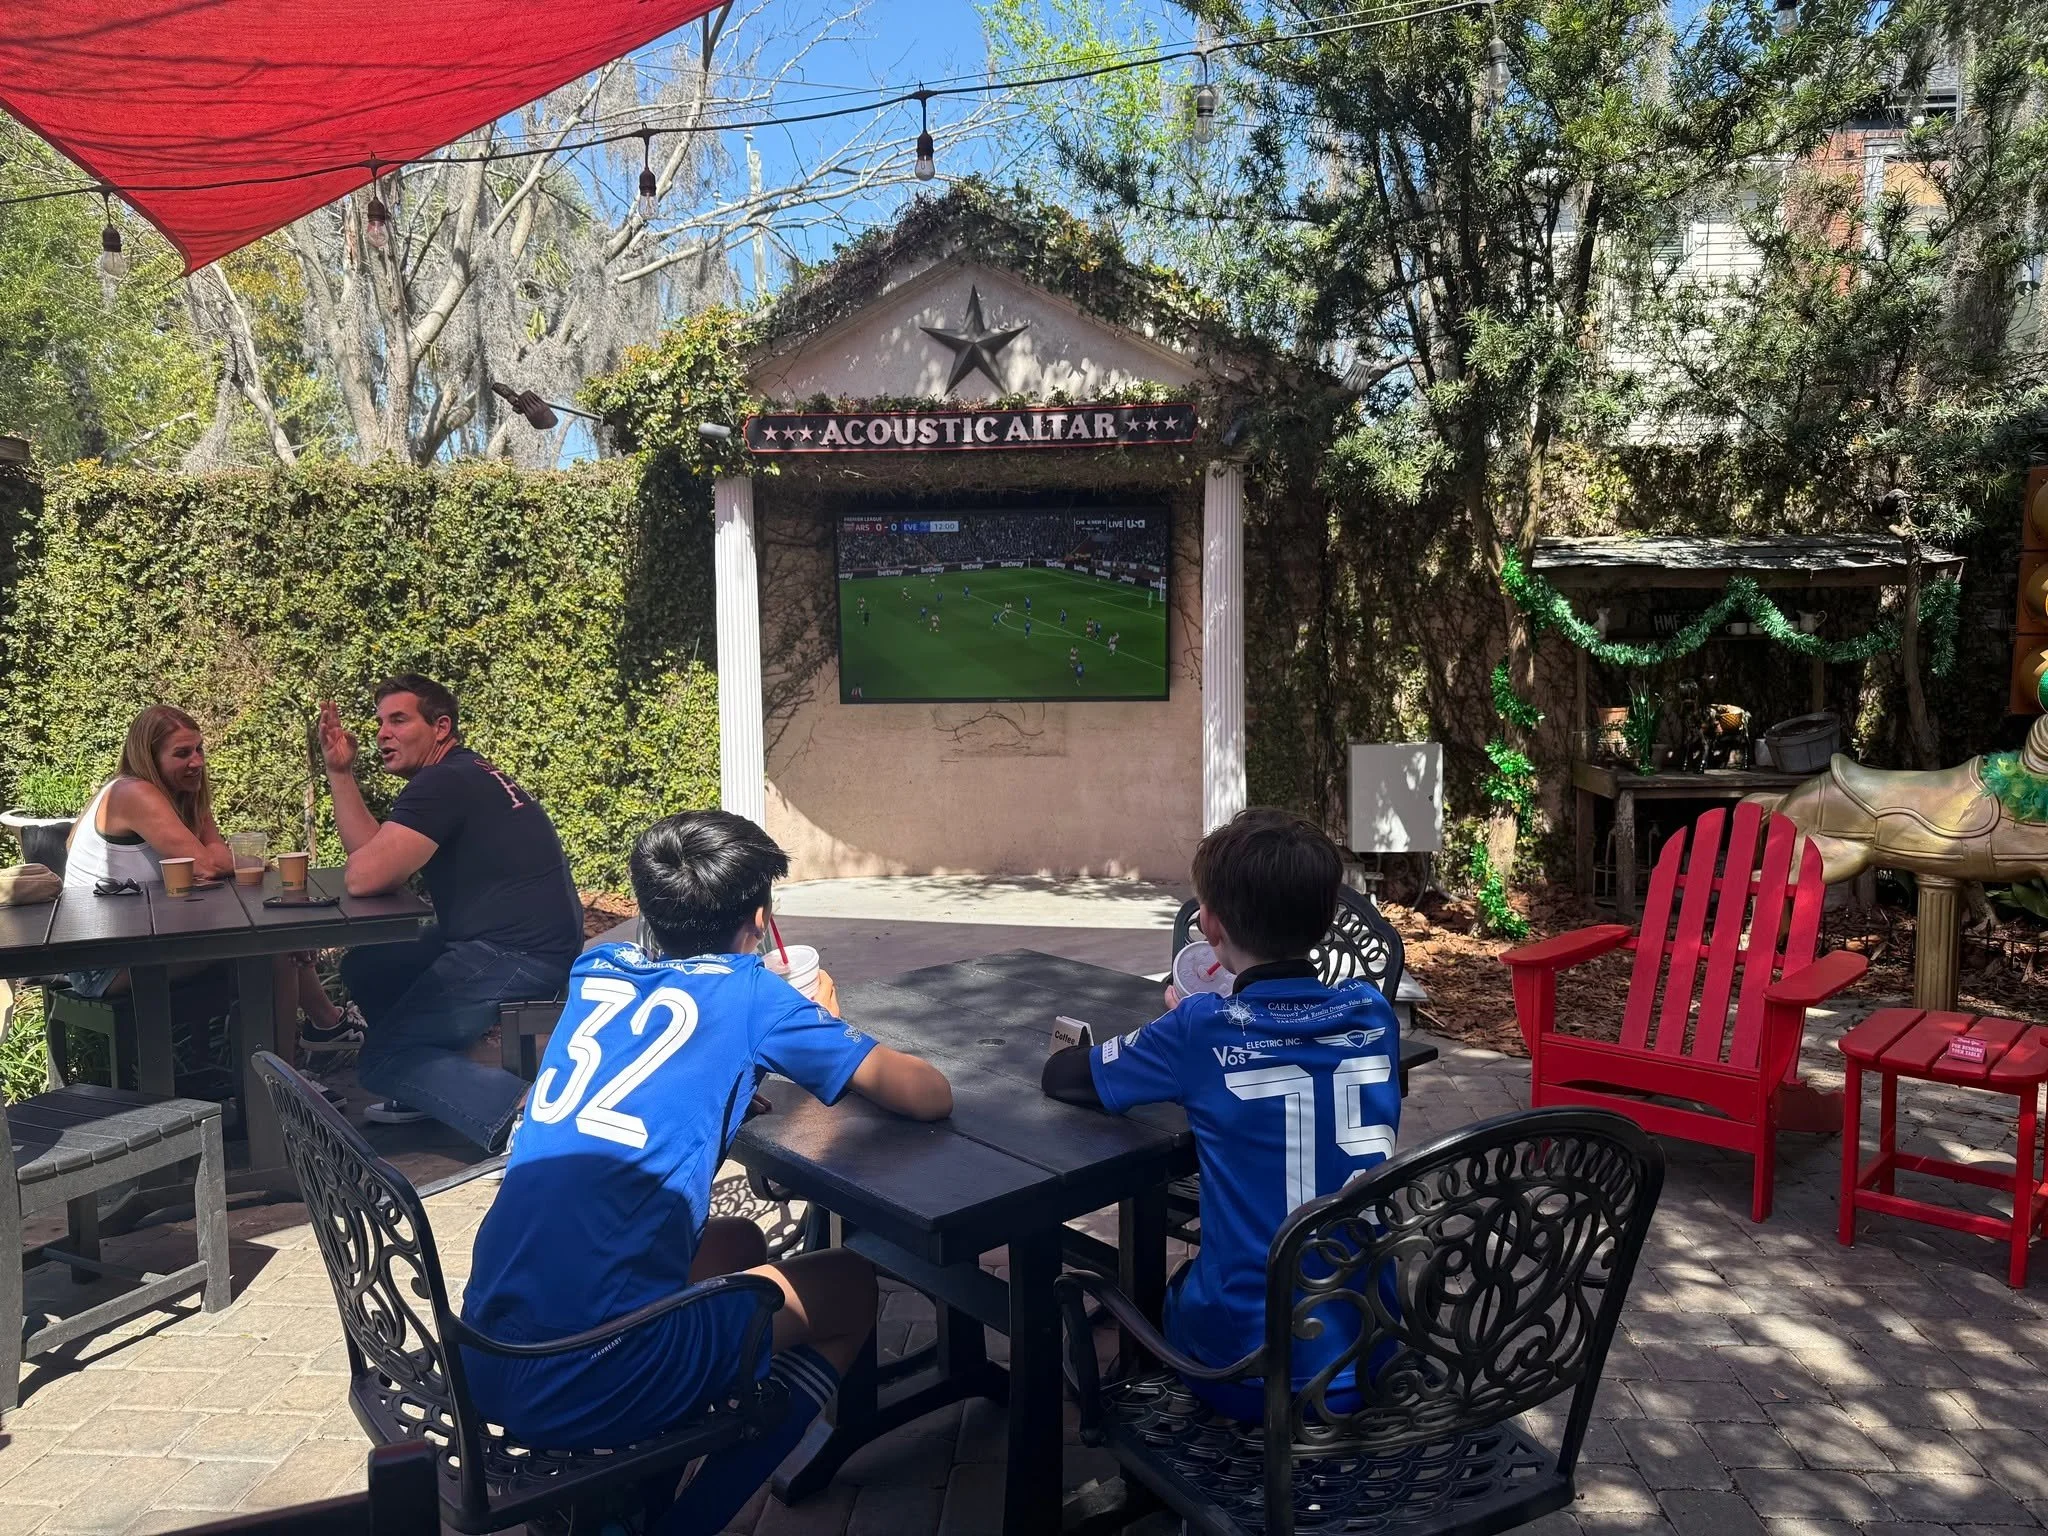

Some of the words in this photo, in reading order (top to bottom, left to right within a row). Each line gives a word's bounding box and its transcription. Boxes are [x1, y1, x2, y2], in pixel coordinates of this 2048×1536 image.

[819, 417, 998, 446] ACOUSTIC
[1004, 412, 1117, 442] ALTAR
[903, 523, 919, 531] EVE
[1108, 520, 1123, 529] LIVE
[921, 565, 945, 573] betway
[960, 562, 984, 571] betway
[1000, 560, 1024, 569] betway
[877, 568, 903, 577] betway
[1267, 1002, 1293, 1011] CARL
[1055, 1030, 1076, 1045] Coffee
[1246, 1039, 1283, 1050] ELECTRIC
[1285, 1037, 1303, 1047] INC.
[531, 976, 699, 1149] 32
[1224, 1055, 1396, 1234] 75
